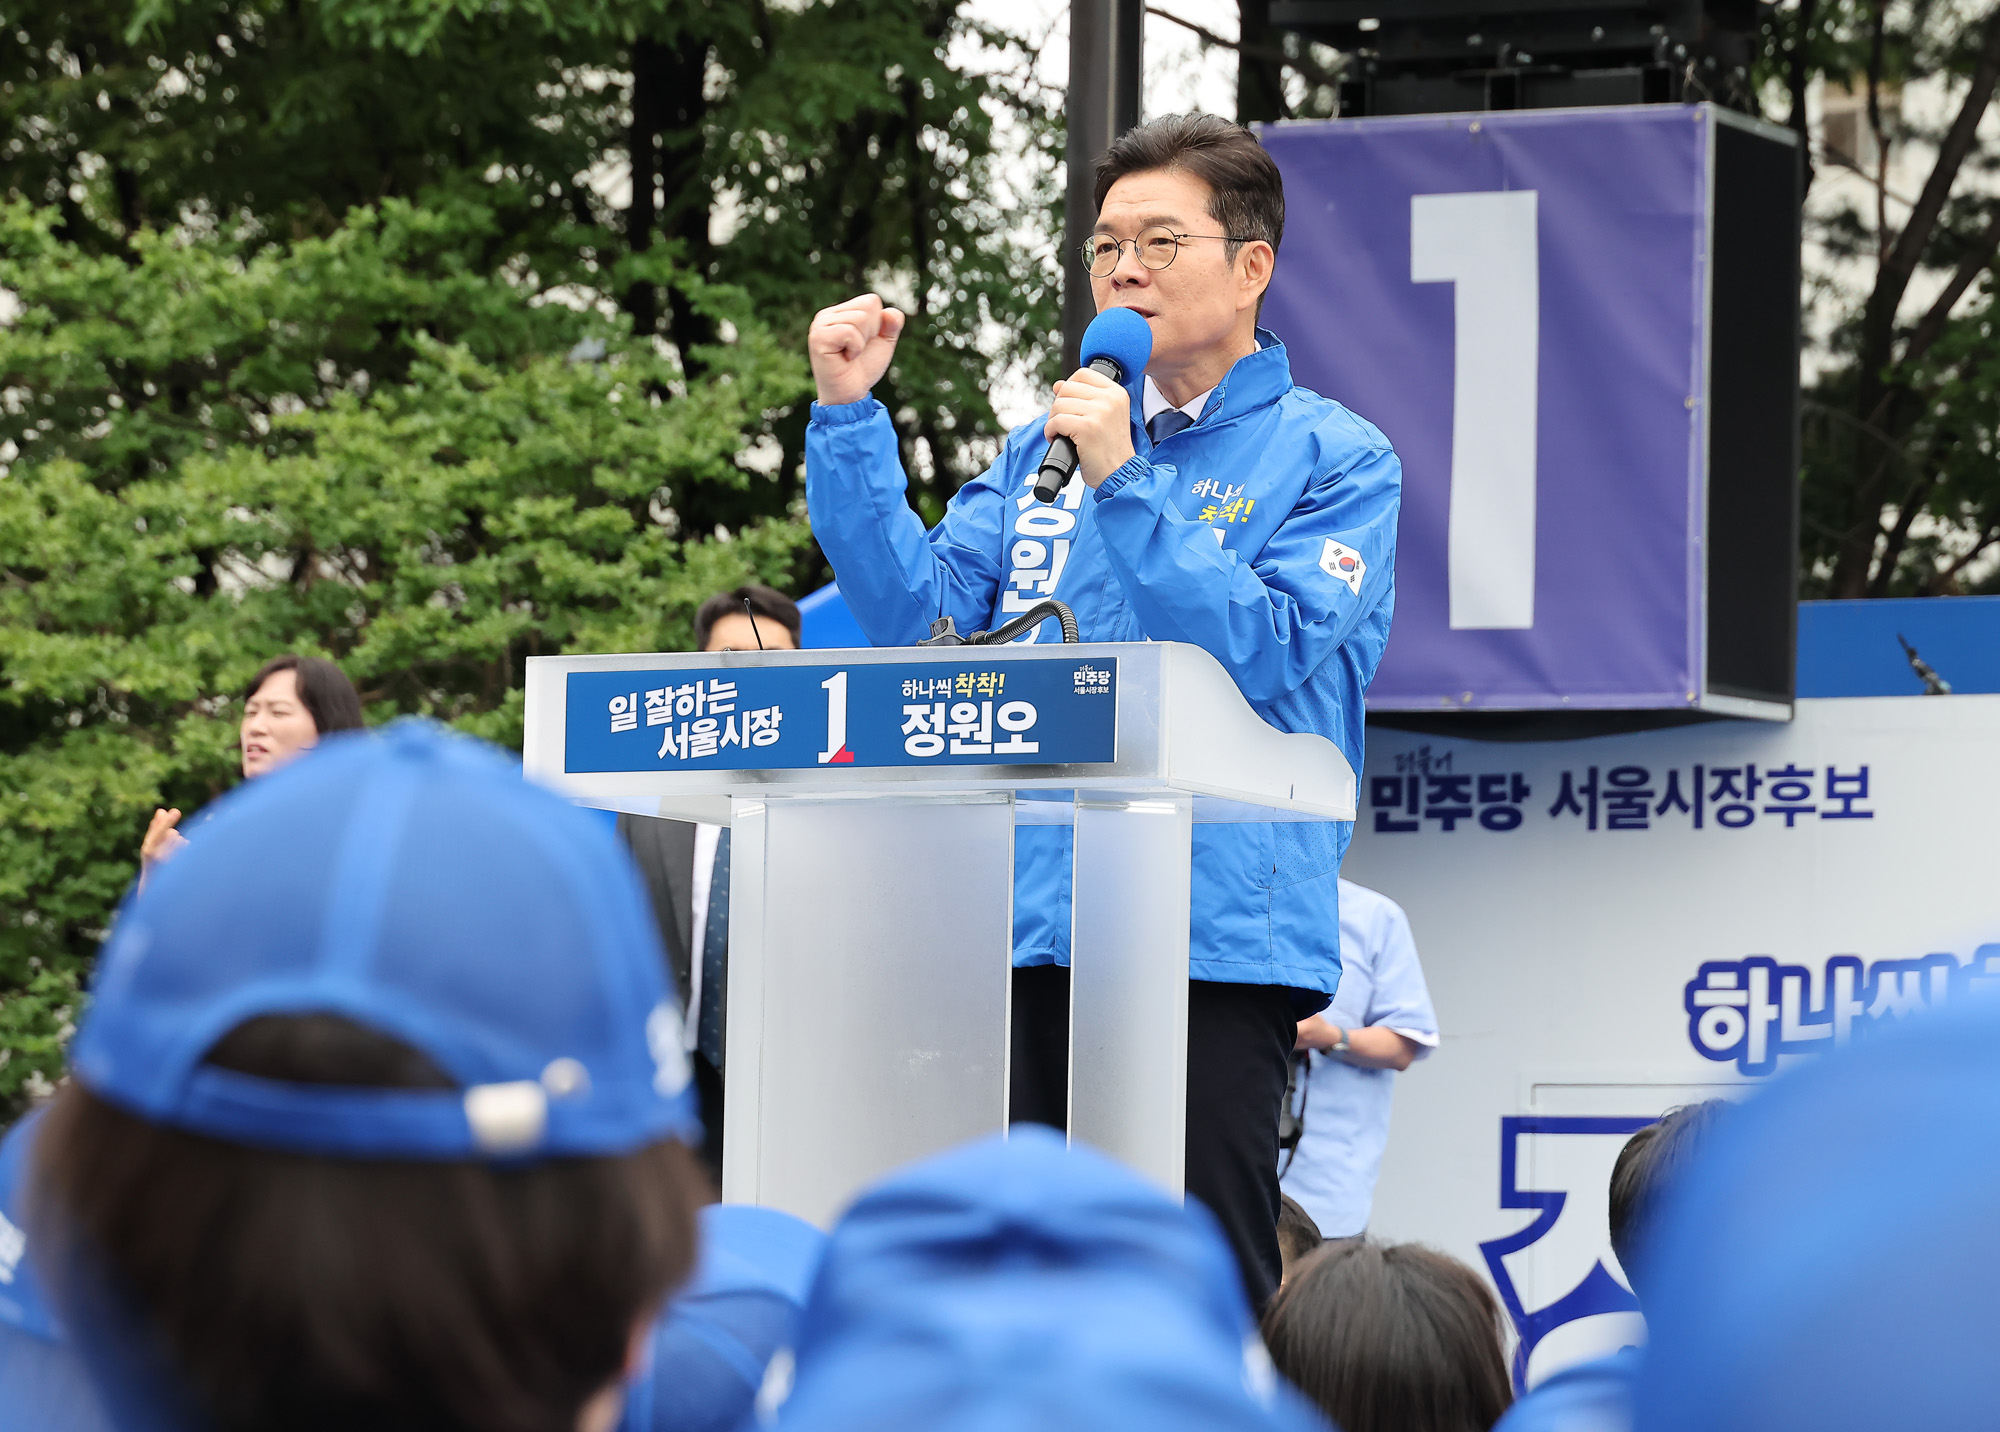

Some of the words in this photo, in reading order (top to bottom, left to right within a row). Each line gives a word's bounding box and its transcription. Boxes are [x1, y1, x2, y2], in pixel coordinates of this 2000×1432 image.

[1411, 190, 1539, 630] 1
[608, 692, 638, 733] 일
[644, 678, 738, 727] 잘하는
[901, 678, 952, 700] 하나씩
[954, 671, 1006, 698] 착착!
[1073, 671, 1111, 685] 민주당
[657, 705, 783, 760] 서울시장
[817, 671, 855, 765] 1
[900, 700, 1040, 757] 정원오
[1370, 772, 1531, 833] 민주당
[1550, 763, 1875, 831] 서울시장후보
